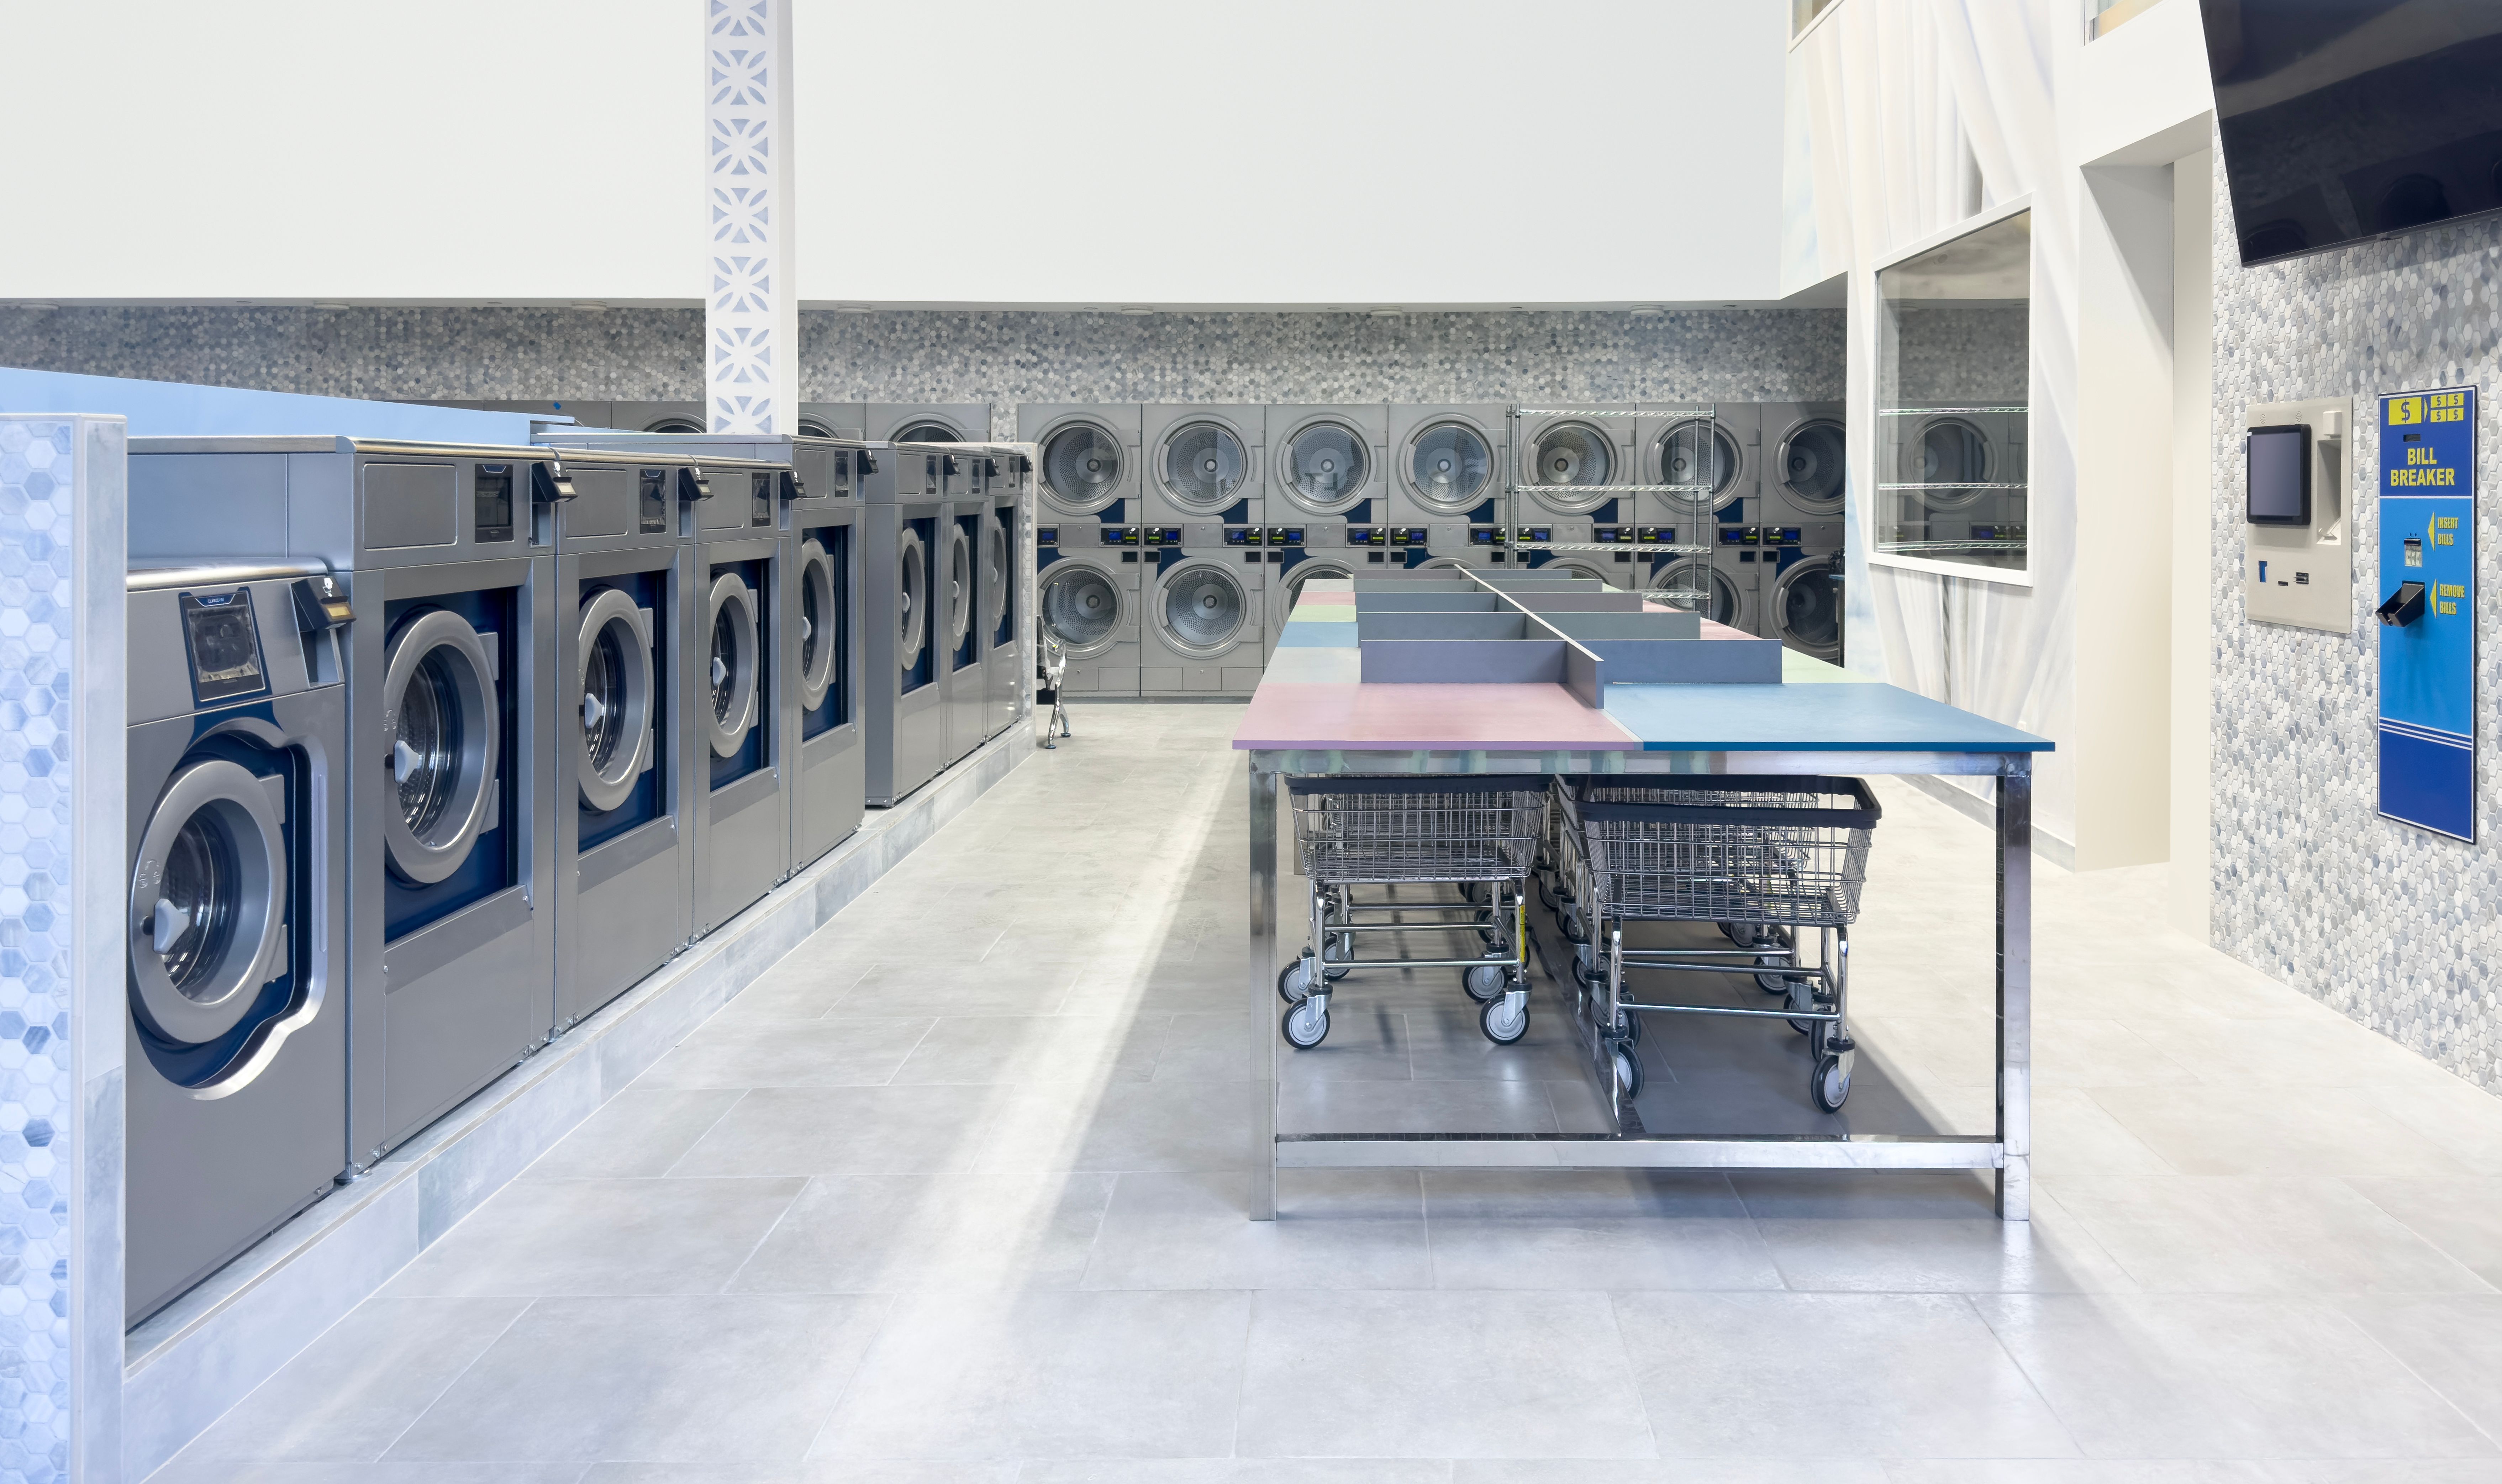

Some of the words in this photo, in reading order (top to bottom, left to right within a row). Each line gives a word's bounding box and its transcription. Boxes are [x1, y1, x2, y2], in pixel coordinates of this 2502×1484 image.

[2436, 396, 2441, 406] $
[2453, 394, 2459, 405] $
[2401, 399, 2410, 423] $
[2436, 411, 2441, 421] $
[2453, 409, 2458, 419] $
[2407, 447, 2437, 465] BILL
[2391, 468, 2455, 486] BREAKER
[2438, 517, 2458, 529] INSERT
[2438, 533, 2453, 545] BILLS
[2440, 584, 2465, 598] REMOVE
[2440, 601, 2456, 615] BILLS
